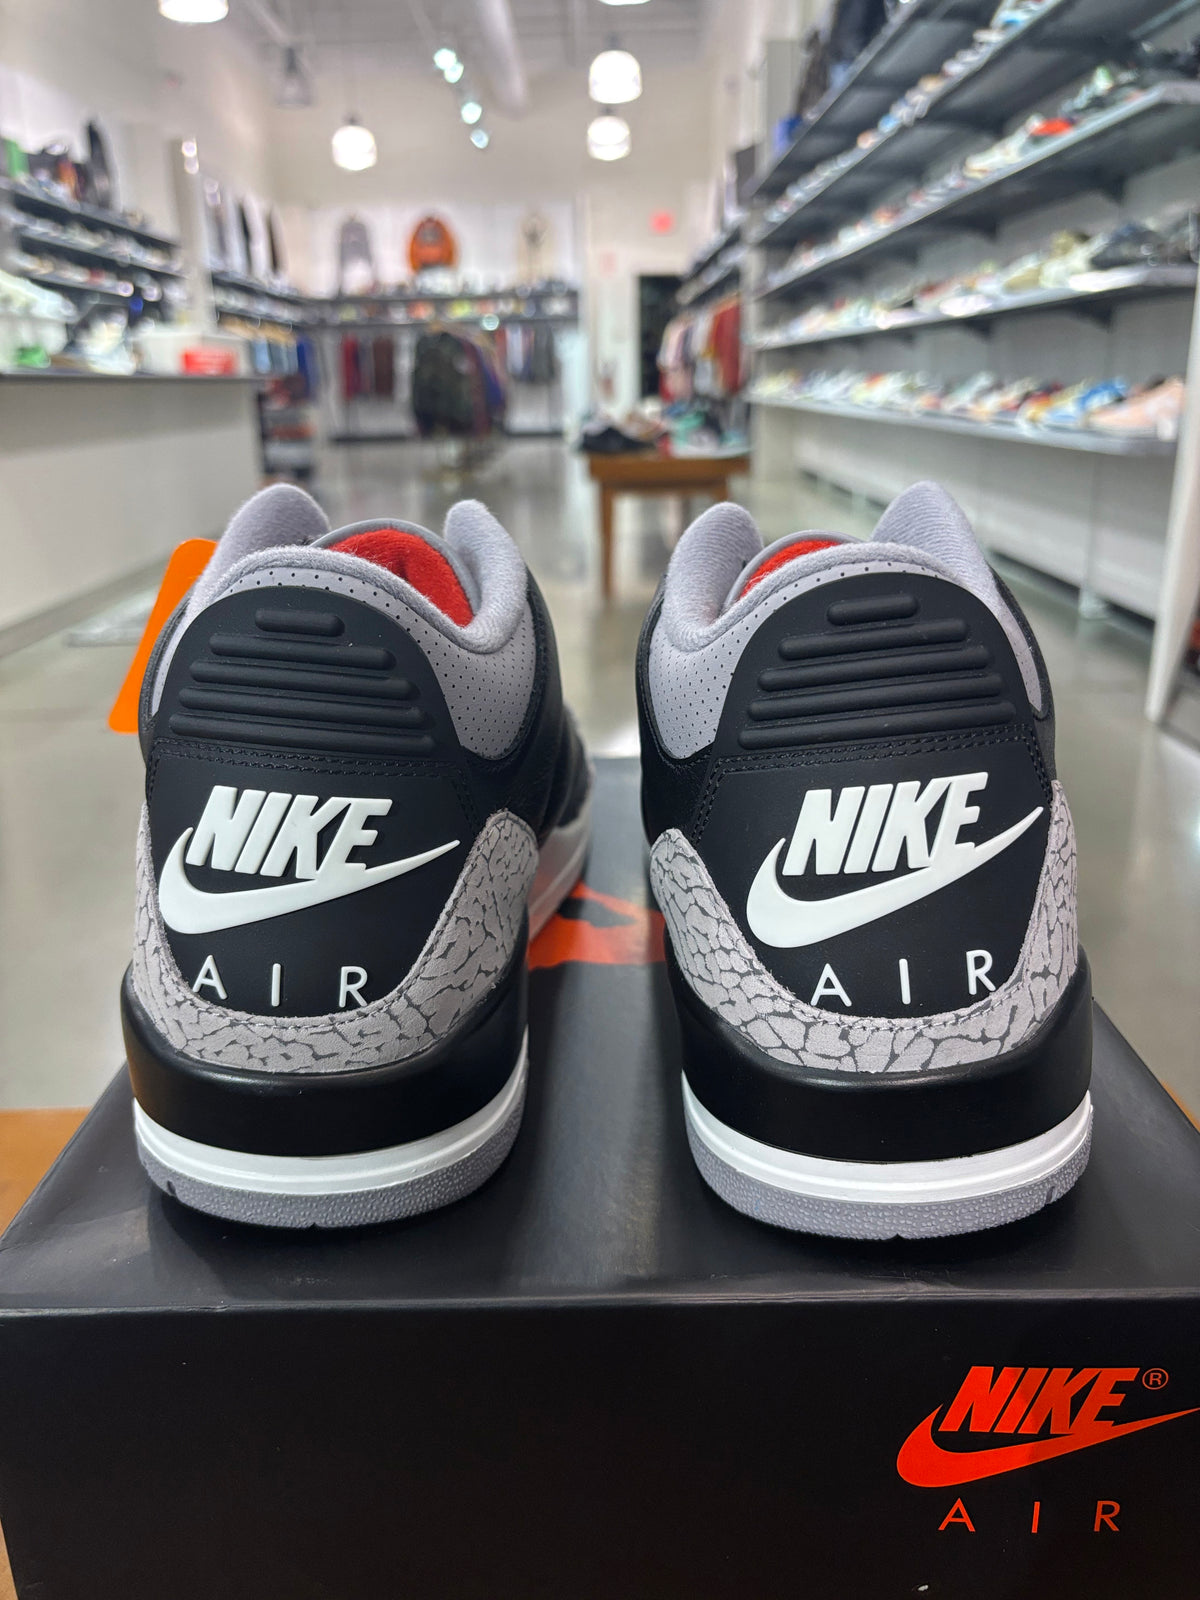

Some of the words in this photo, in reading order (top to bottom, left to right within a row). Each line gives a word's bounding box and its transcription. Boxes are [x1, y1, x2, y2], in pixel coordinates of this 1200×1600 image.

[187, 785, 393, 880] NIKE
[782, 771, 989, 876] NIKE
[193, 954, 369, 1008] AIR
[810, 949, 996, 1007] AIR
[938, 1497, 1121, 1535] AIR
